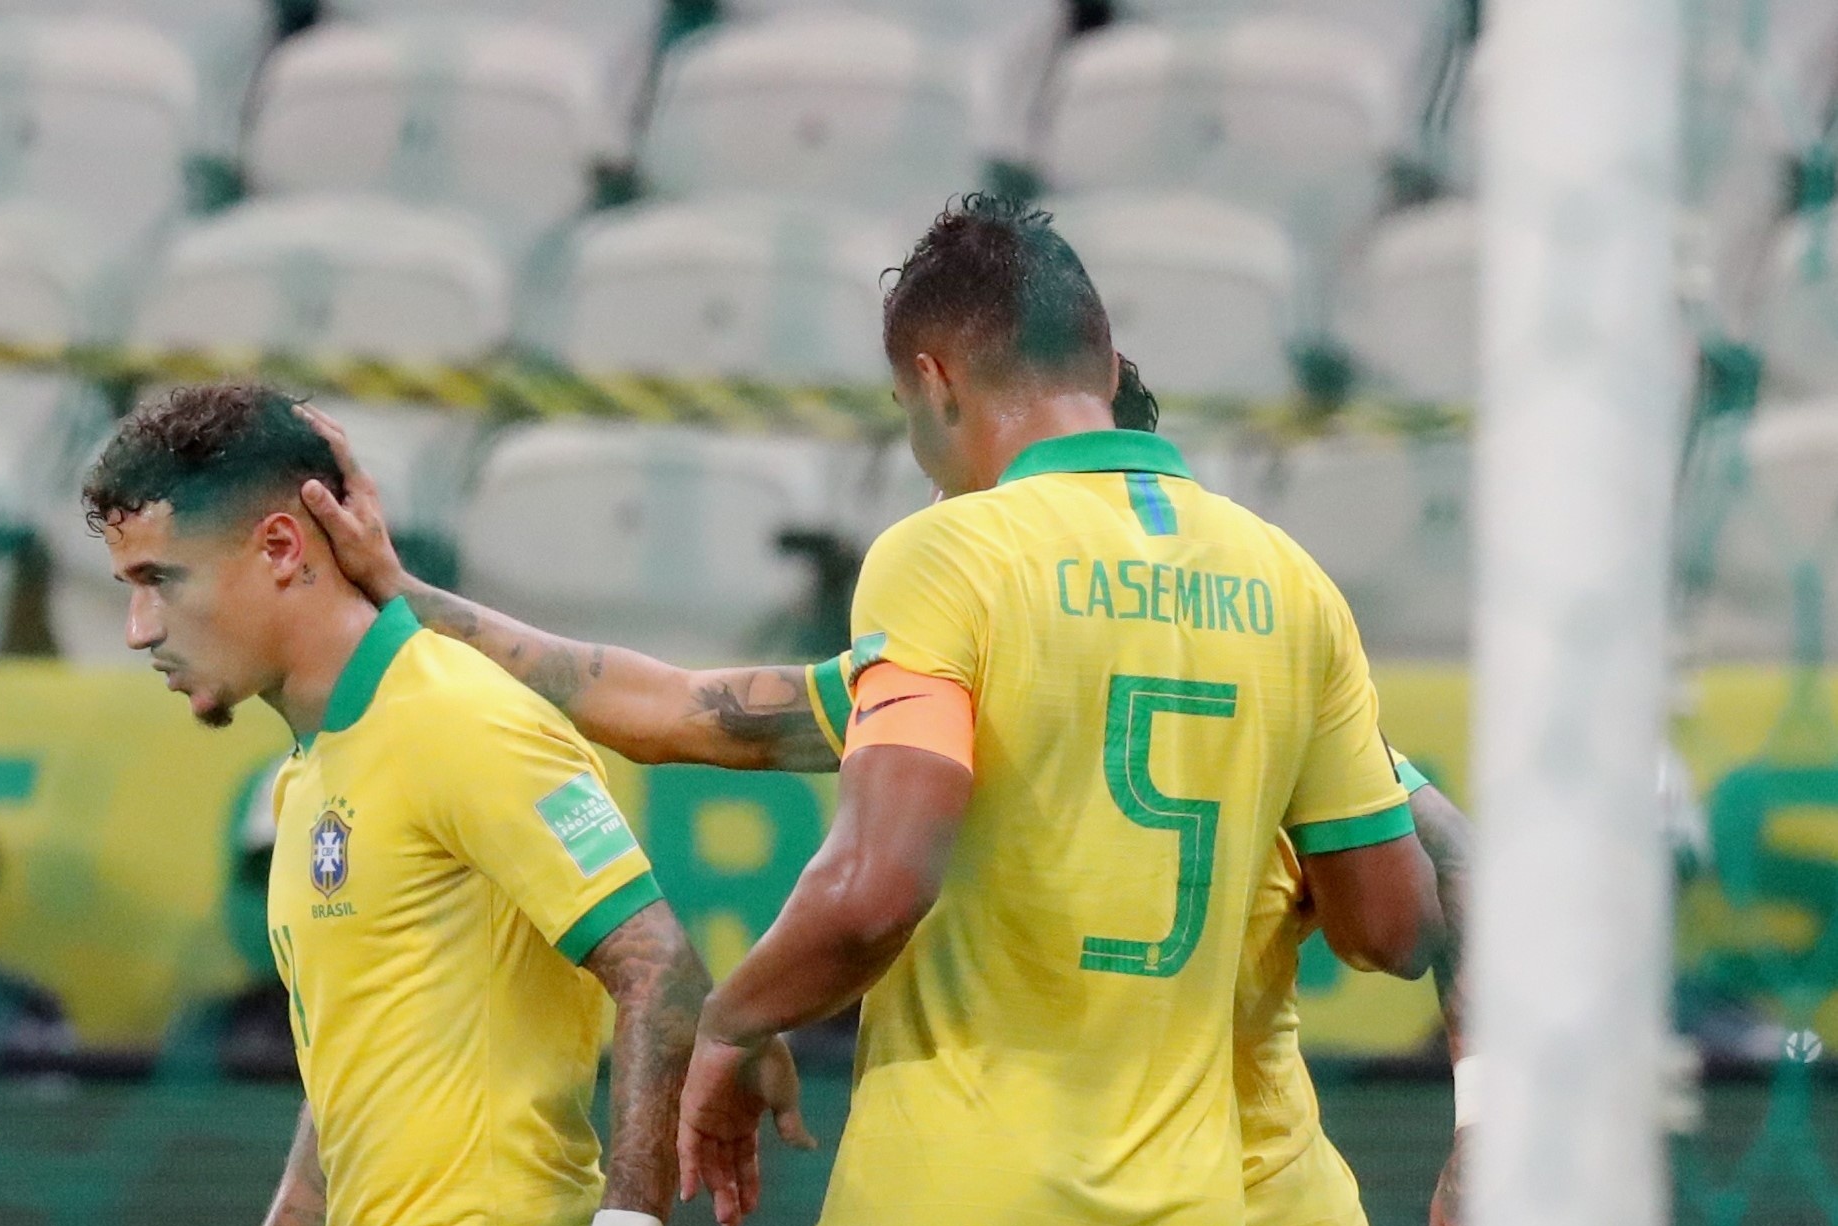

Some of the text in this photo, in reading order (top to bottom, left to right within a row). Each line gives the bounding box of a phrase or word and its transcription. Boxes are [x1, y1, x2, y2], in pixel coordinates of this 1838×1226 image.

[1056, 558, 1275, 637] CASEMIRO
[561, 800, 610, 836] FOOTBALL
[1079, 673, 1238, 978] 5
[311, 901, 357, 919] BRASIL
